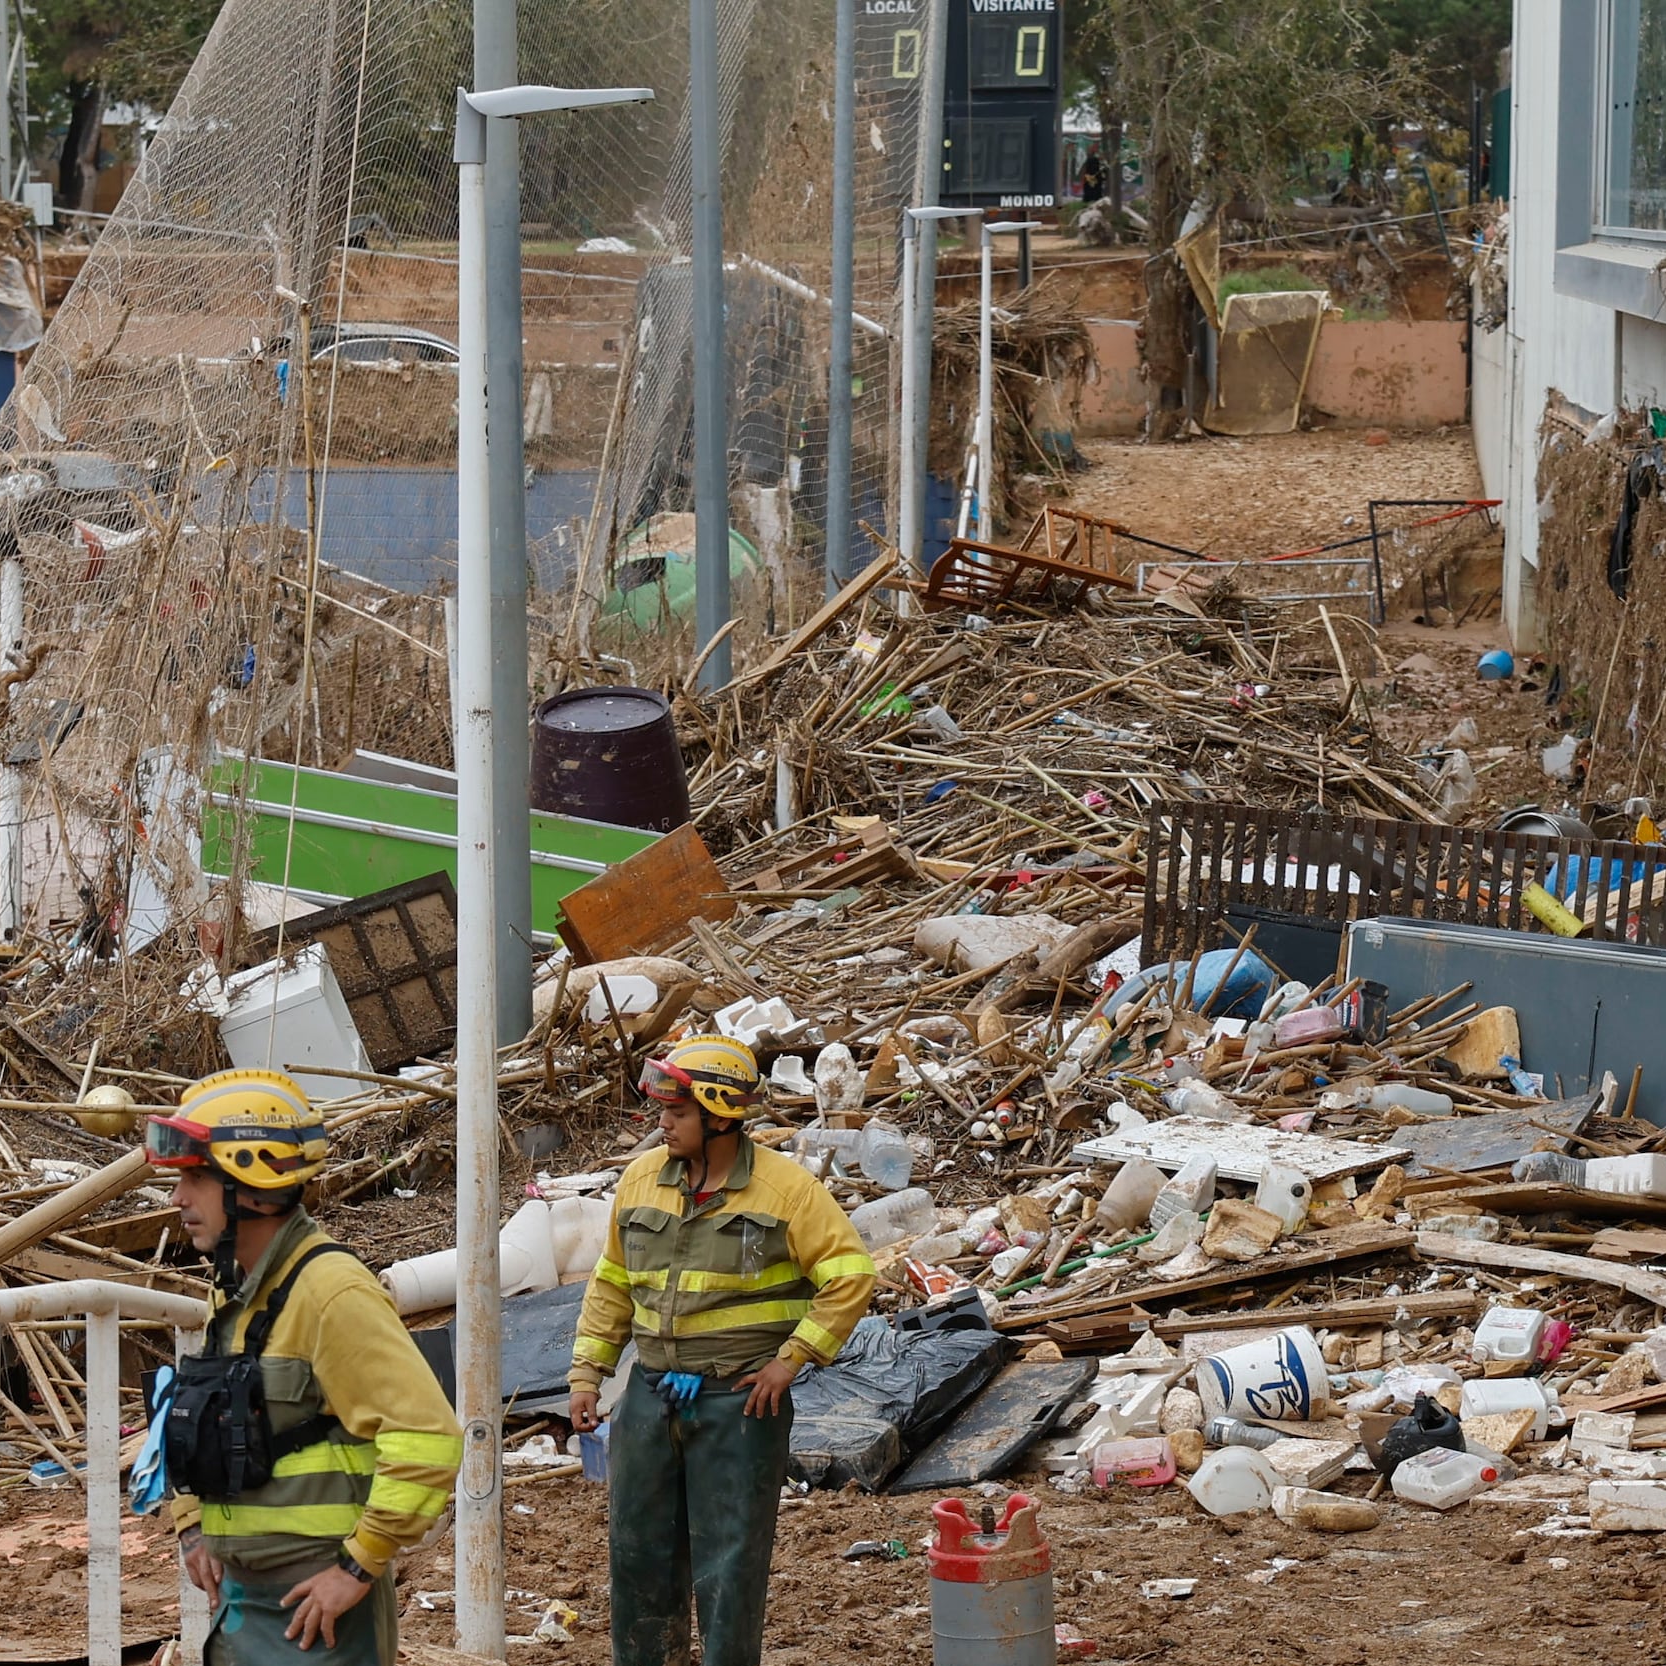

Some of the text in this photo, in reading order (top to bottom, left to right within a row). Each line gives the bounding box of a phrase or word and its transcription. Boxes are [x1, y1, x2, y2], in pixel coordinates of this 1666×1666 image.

[865, 0, 916, 14] LOCAL
[973, 0, 1055, 12] VISITANTE
[893, 29, 921, 79] 0
[1015, 26, 1045, 76] 0
[1000, 194, 1054, 208] MONDO
